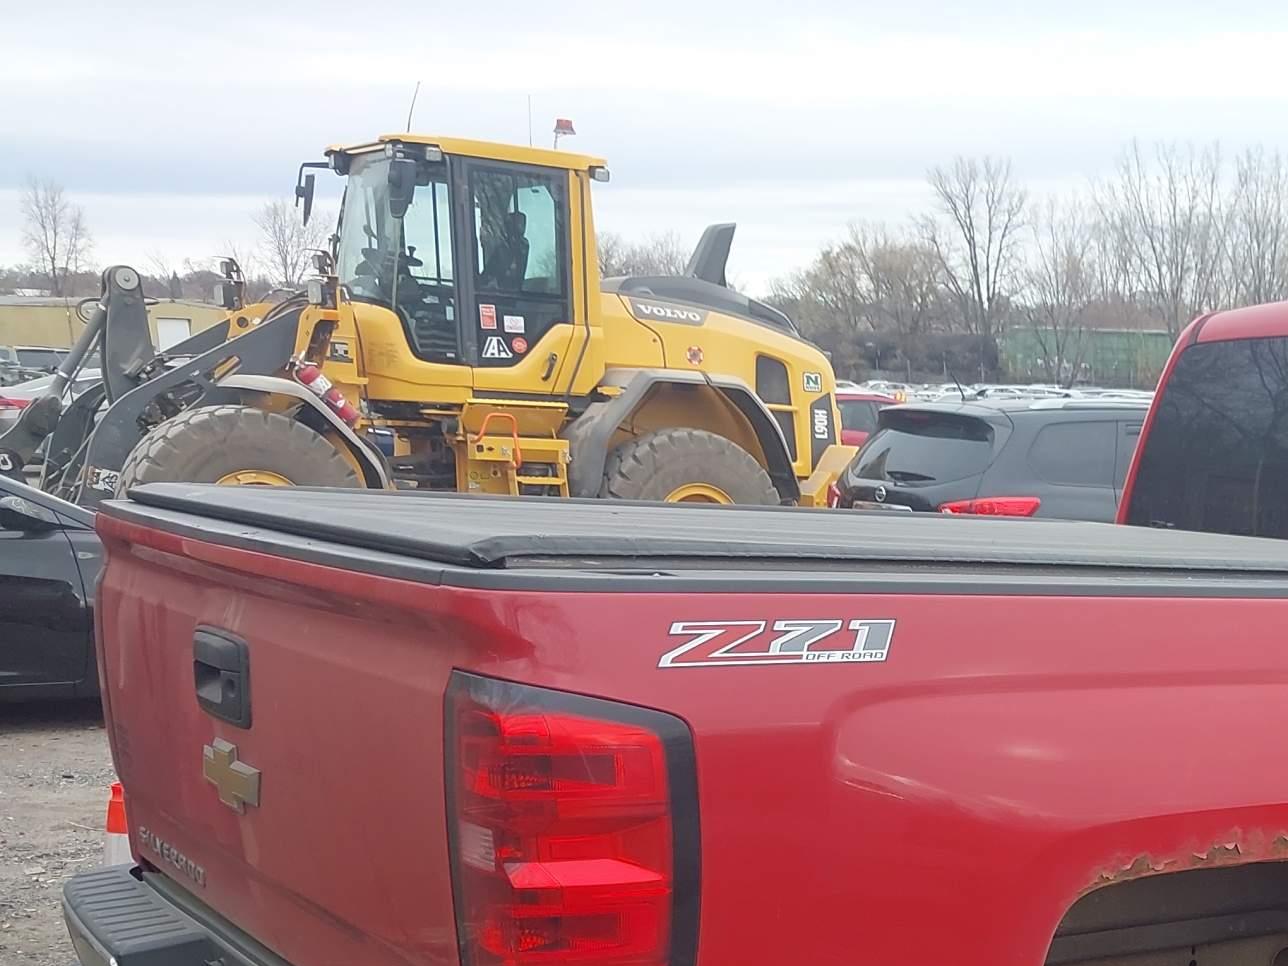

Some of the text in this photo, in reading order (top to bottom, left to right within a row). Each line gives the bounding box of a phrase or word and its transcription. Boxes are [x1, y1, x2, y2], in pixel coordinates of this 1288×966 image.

[637, 303, 702, 322] VOLVO
[814, 408, 829, 440] L90H
[656, 619, 897, 668] Z71
[805, 651, 885, 661] OFF ROAD
[139, 826, 208, 887] SILVERADO
